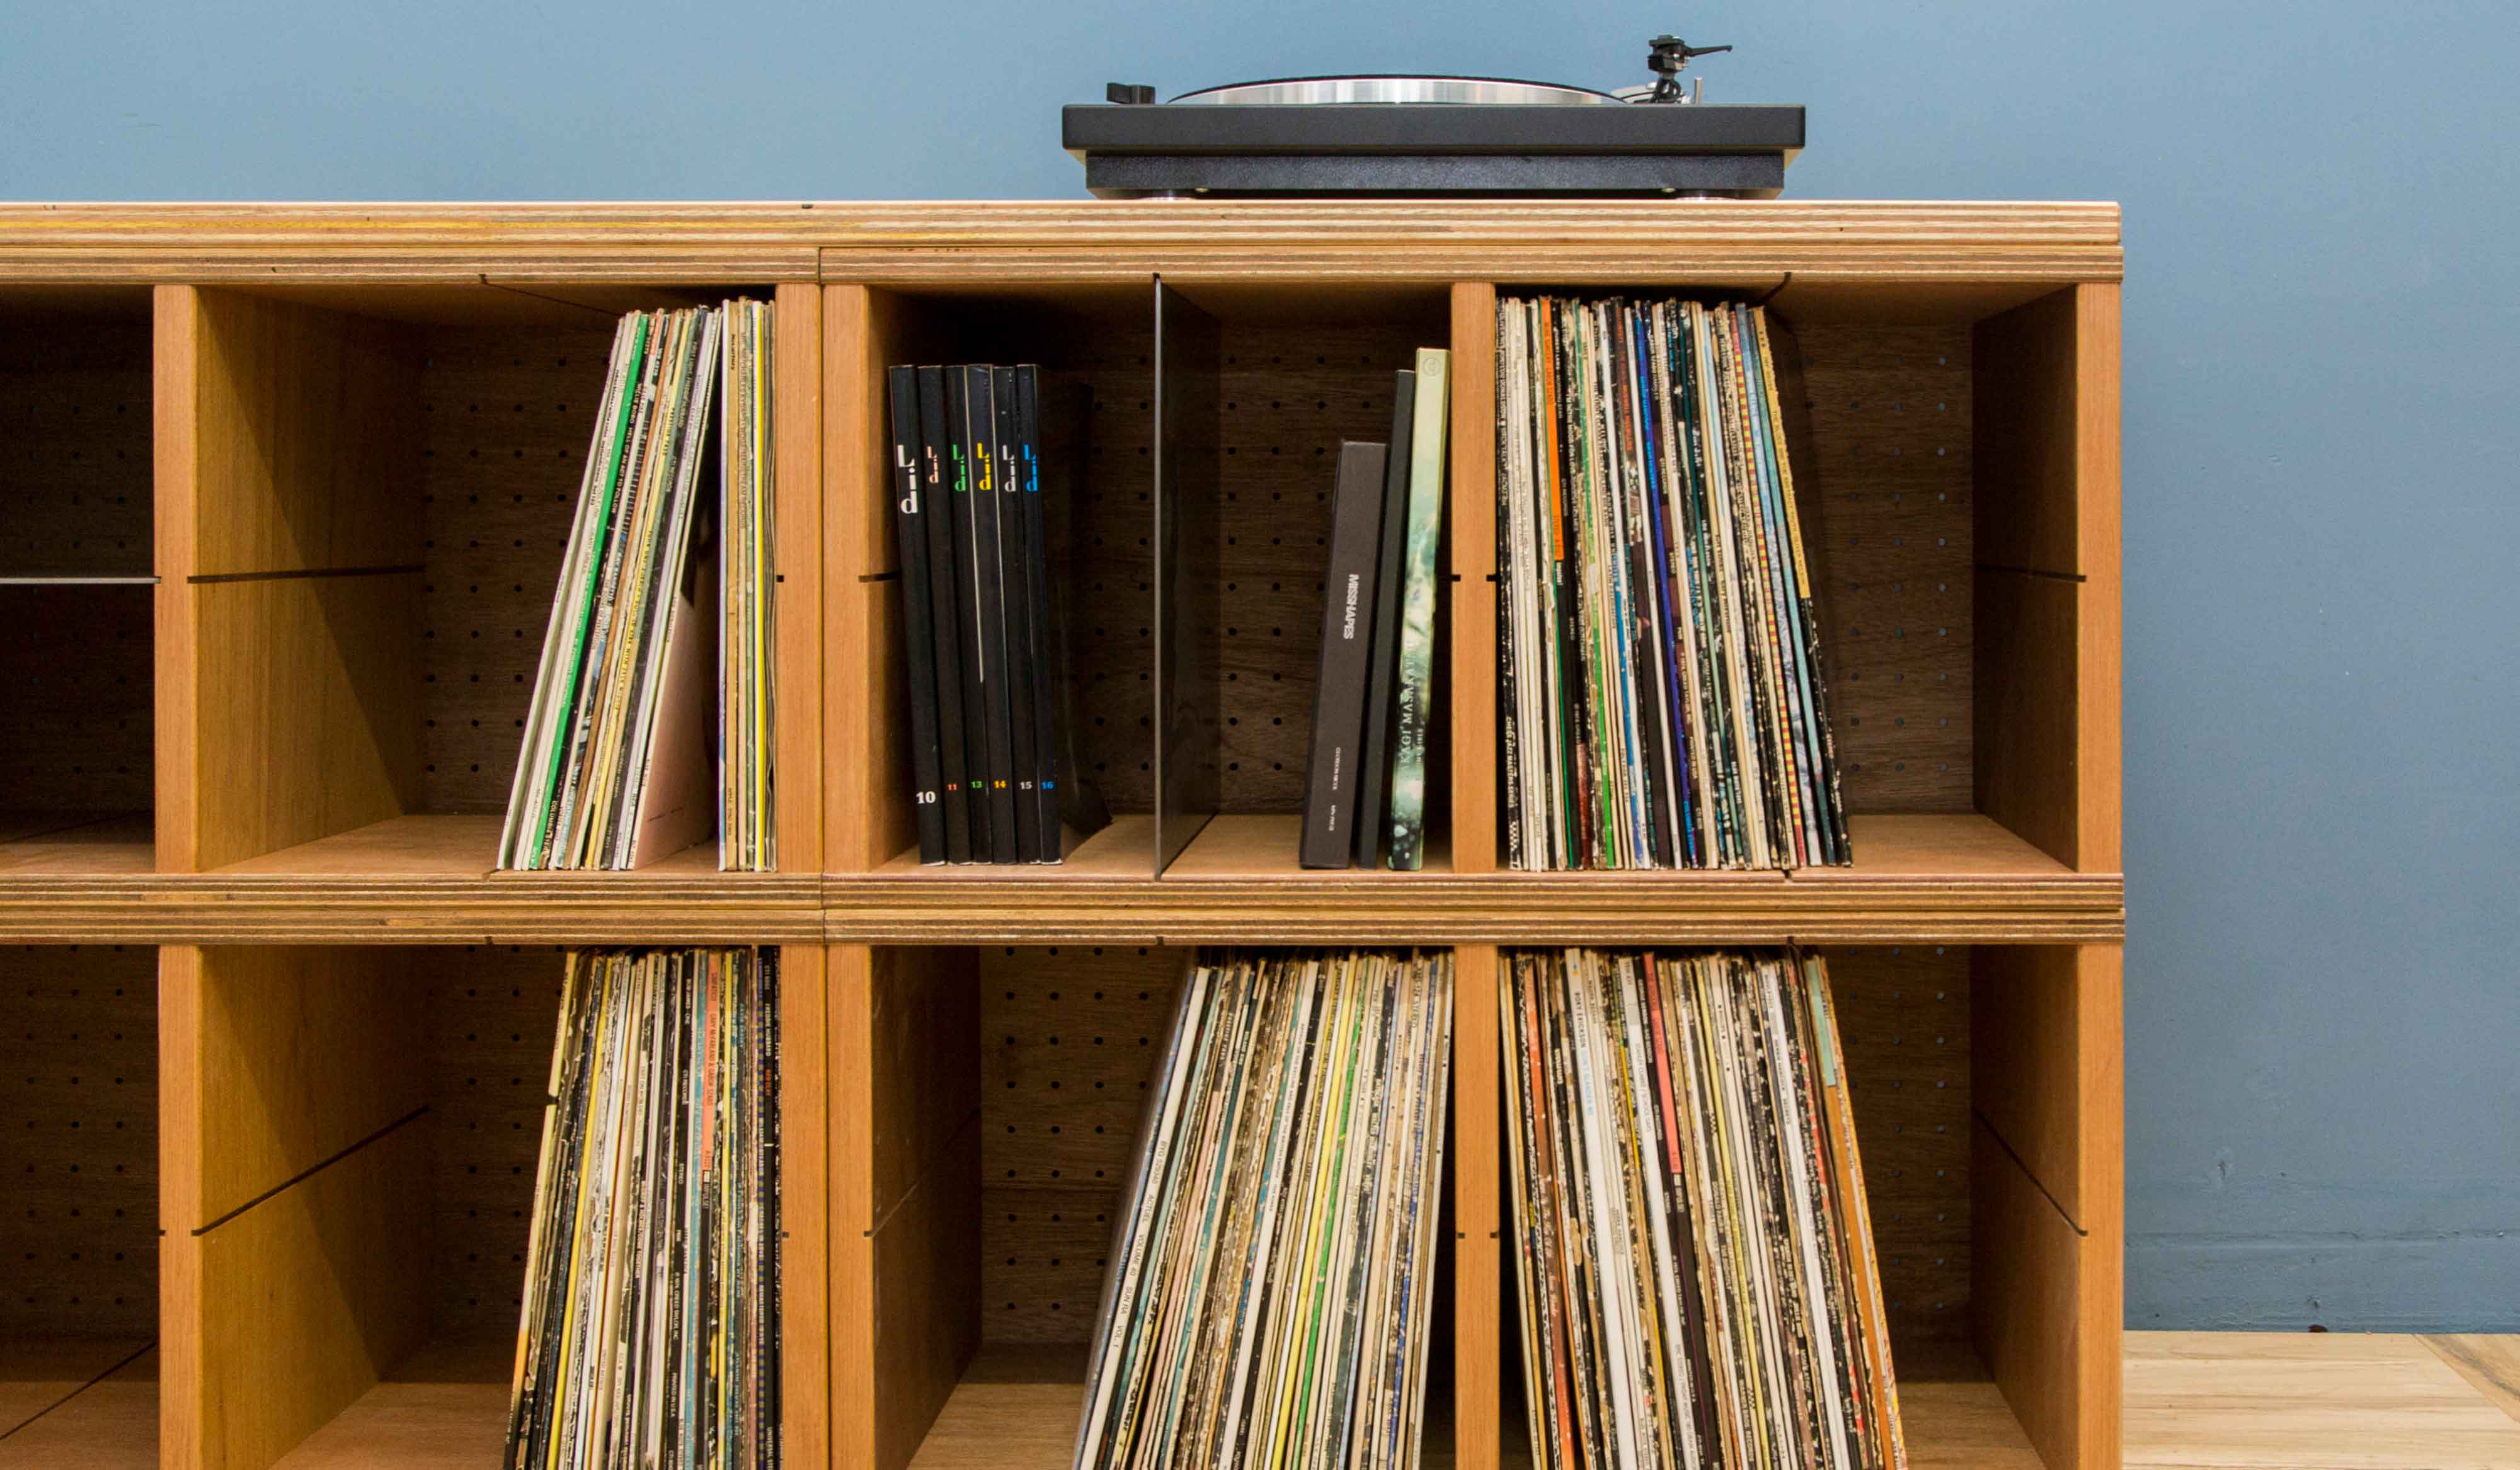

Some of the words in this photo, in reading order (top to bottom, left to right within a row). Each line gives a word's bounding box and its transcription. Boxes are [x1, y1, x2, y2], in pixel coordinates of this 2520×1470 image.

[629, 404, 638, 424] BOBO
[1343, 574, 1360, 639] MISSHAPES
[971, 780, 983, 789] 13
[993, 780, 1007, 789] 14
[1019, 781, 1032, 790] 15
[1041, 781, 1053, 789] 16
[916, 791, 936, 804] 10
[1574, 991, 1583, 1010] ROKY
[1575, 1012, 1588, 1047] ERICKSON
[1140, 1194, 1154, 1224] ACTUEL
[1131, 1233, 1146, 1265] VOLUME
[1123, 1285, 1133, 1301] SUN
